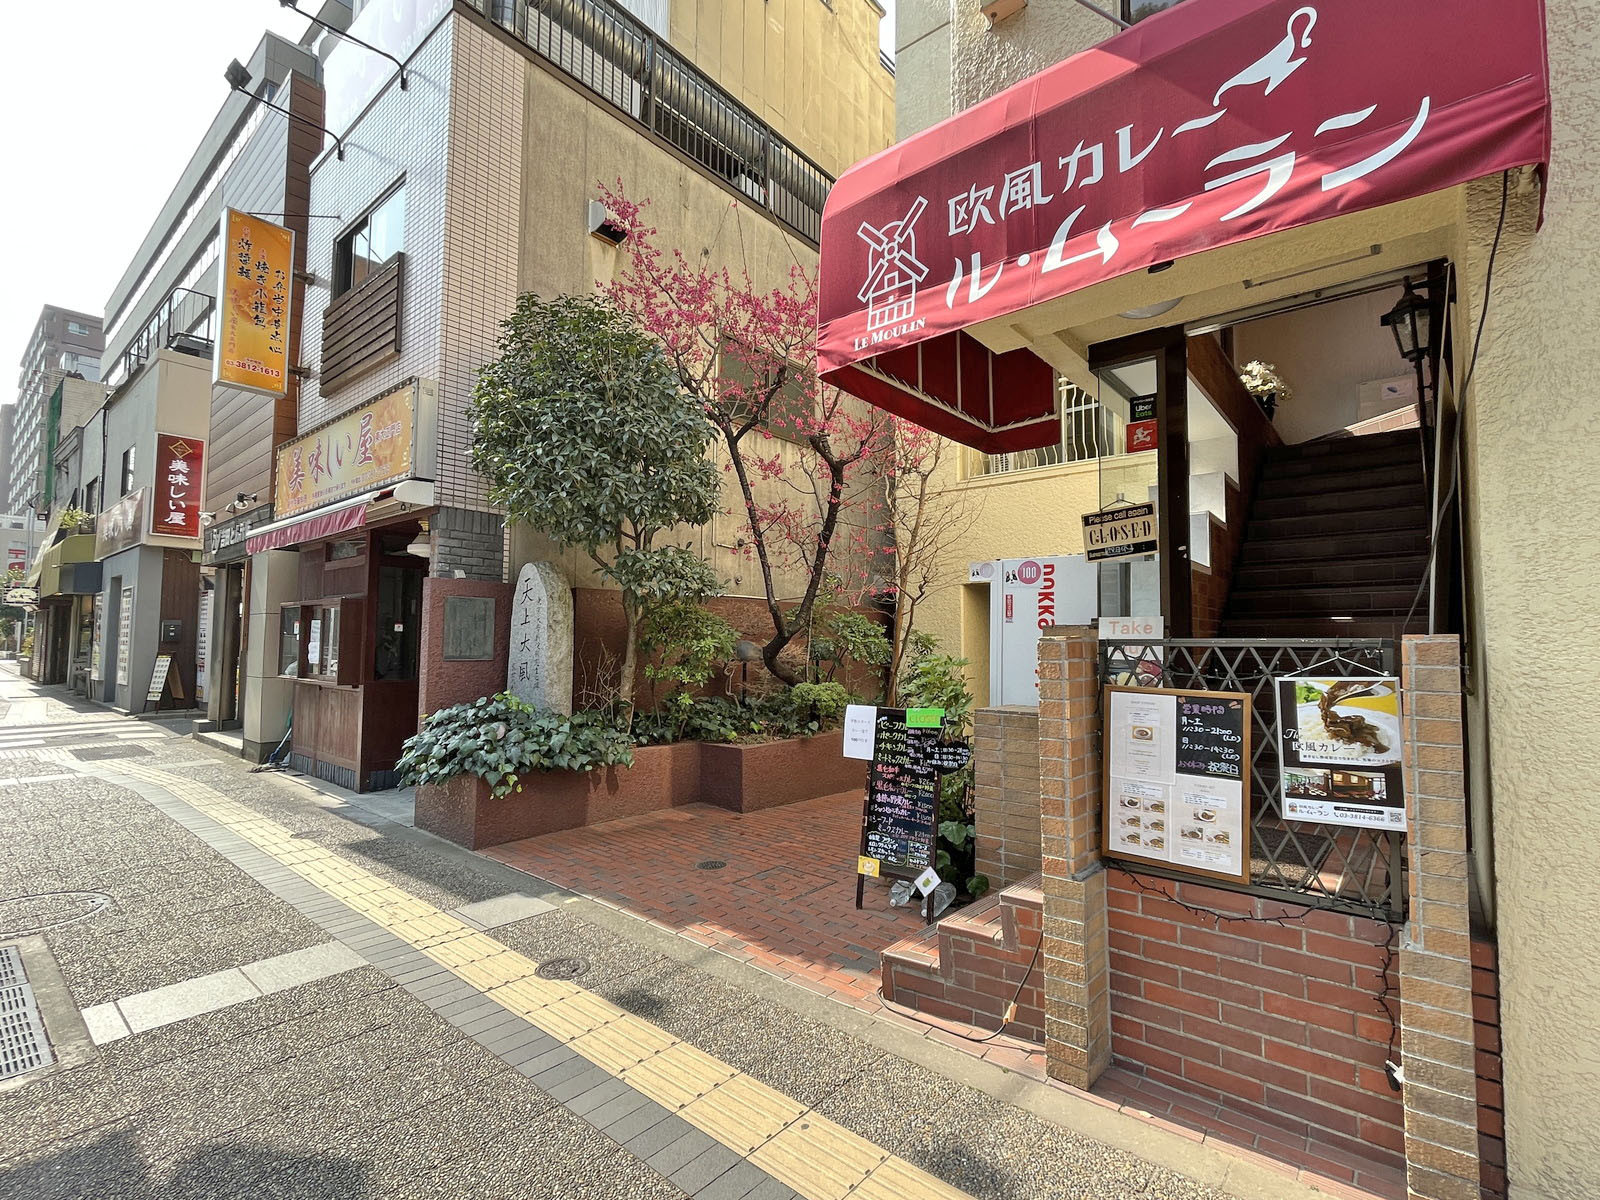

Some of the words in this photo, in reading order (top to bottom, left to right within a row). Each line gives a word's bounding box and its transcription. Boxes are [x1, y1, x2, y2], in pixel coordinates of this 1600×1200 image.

[947, 107, 1228, 237] 欧風カレー
[945, 95, 1431, 310] ル・ムーラン
[854, 337, 869, 351] LE
[871, 317, 926, 346] MOULIN
[225, 359, 281, 378] 03-3812-1613
[1135, 404, 1153, 412] Uber
[1135, 410, 1153, 418] Eats
[288, 411, 374, 492] 美味しい屋
[163, 459, 191, 526] 美味しい屋
[1089, 514, 1113, 524] Please
[1114, 510, 1127, 520] call
[1127, 507, 1149, 517] again
[1022, 566, 1037, 579] 100
[518, 577, 534, 682] 天上大風
[1108, 620, 1153, 635] Take
[1182, 703, 1225, 715] 営業時間
[1292, 740, 1356, 753] 欧風カレー
